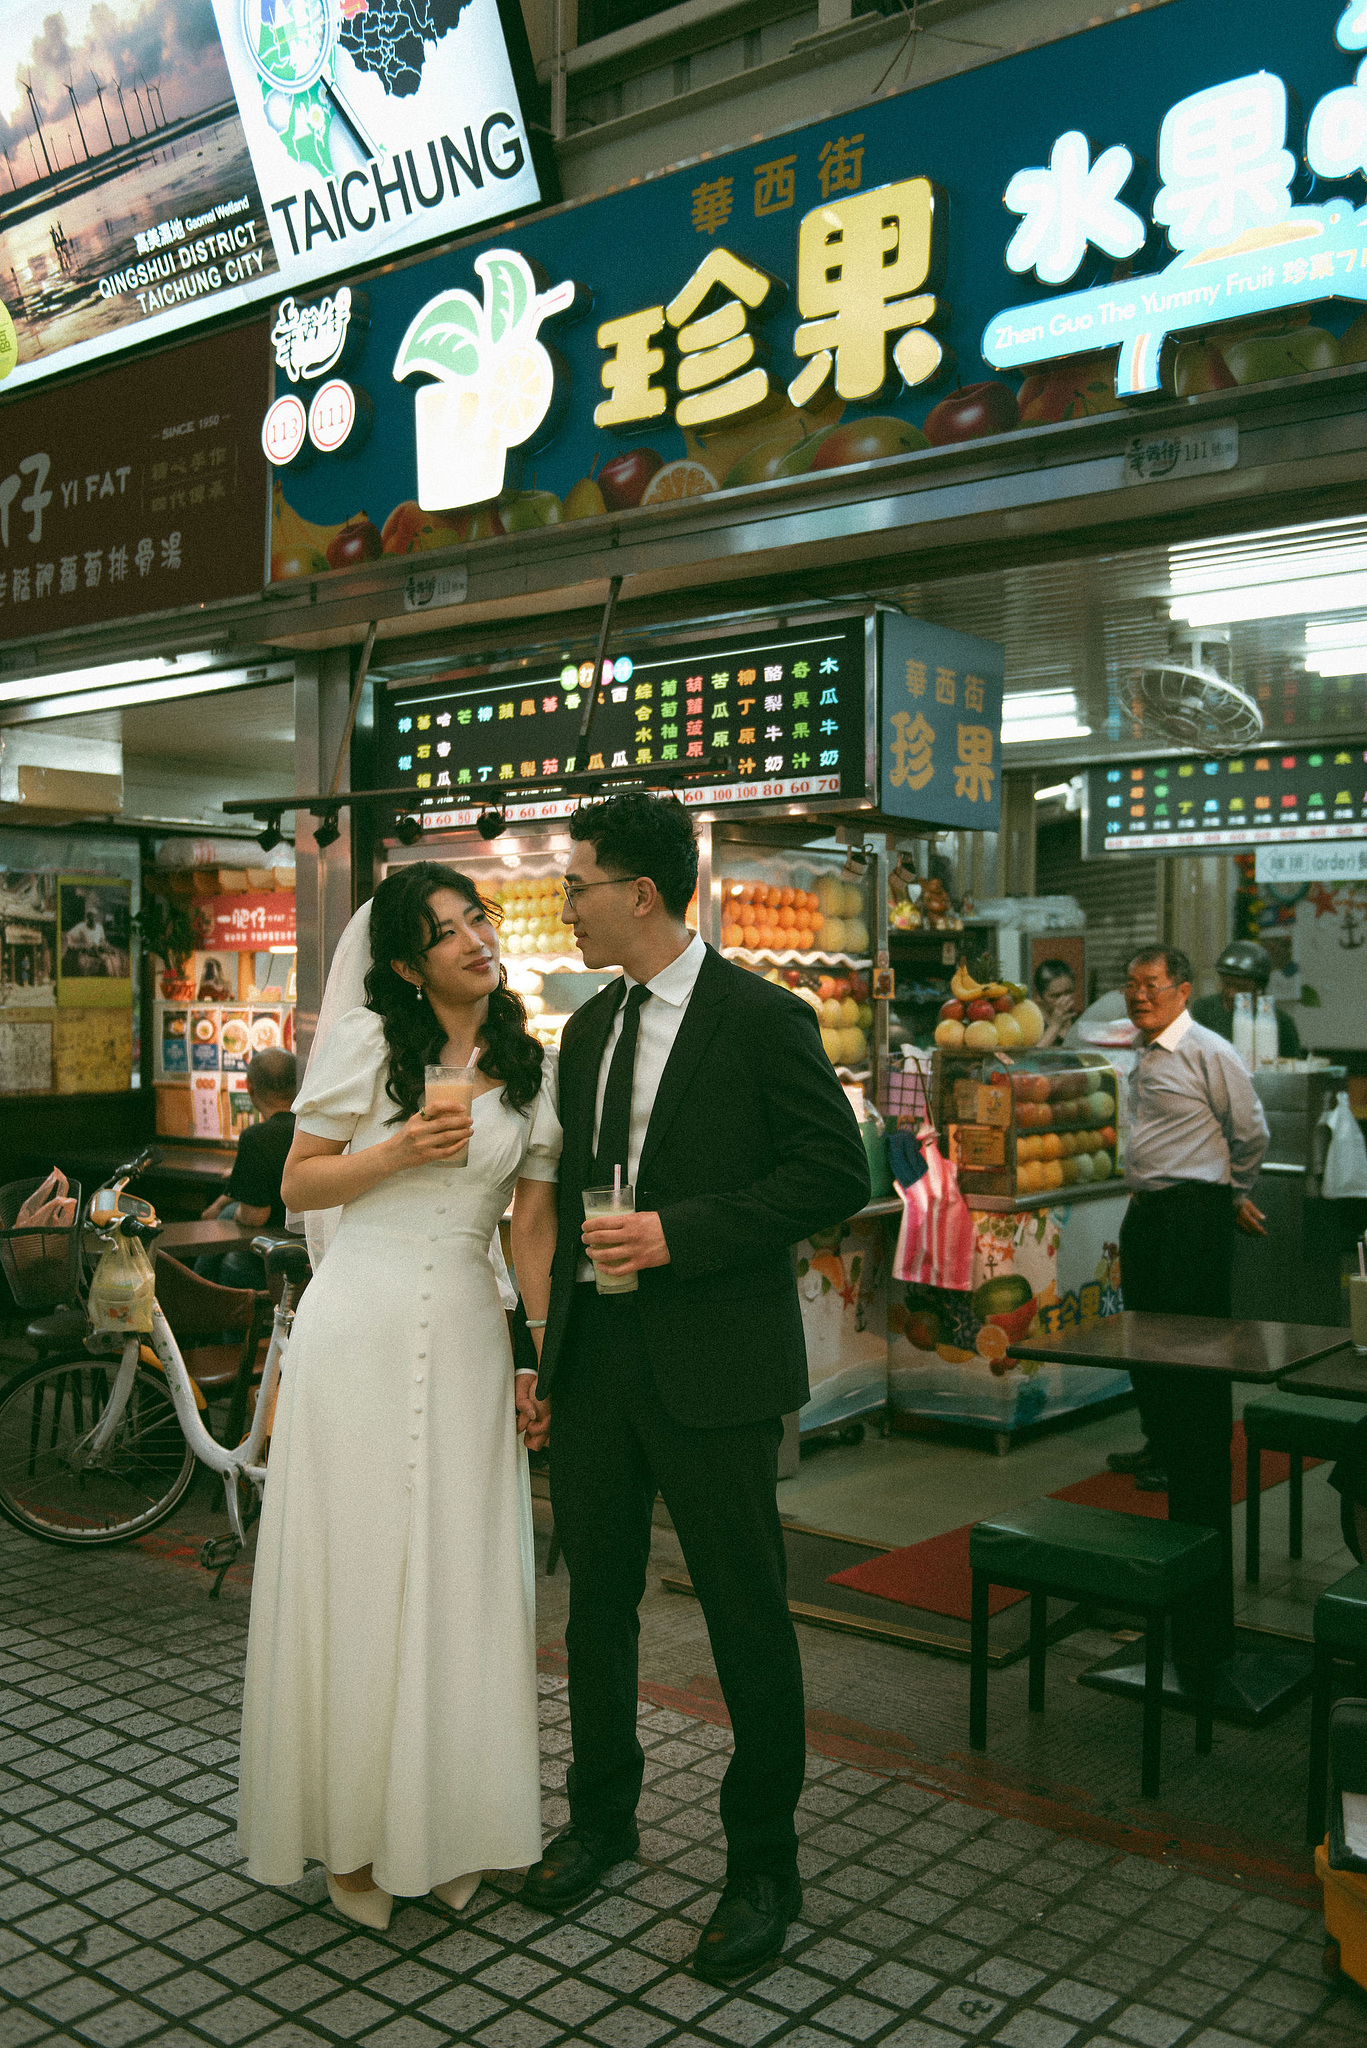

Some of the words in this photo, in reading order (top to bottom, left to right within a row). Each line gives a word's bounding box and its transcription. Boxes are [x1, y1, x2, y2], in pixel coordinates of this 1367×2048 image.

[184, 208, 215, 232] Gaomei
[214, 194, 250, 220] Wetland
[271, 111, 525, 256] TAICHUNG
[691, 133, 865, 235] 華西街
[98, 252, 177, 299] QINGSHUI
[178, 219, 257, 270] DISTRICT
[136, 265, 222, 314] TAICHUNG
[224, 248, 264, 283] CITY
[594, 176, 943, 427] 珍果
[994, 323, 1045, 350] Zhen
[1048, 312, 1094, 337] Guo
[1098, 302, 1137, 325] The
[1140, 282, 1222, 315] Yummy
[1225, 265, 1276, 296] Fruit
[60, 479, 79, 509] YI
[85, 465, 131, 502] FAT
[1185, 440, 1207, 461] 111
[610, 686, 629, 768] 西瓜
[634, 683, 653, 765] 綜合水果
[711, 672, 731, 778] 苦瓜原
[737, 668, 757, 775] 柳丁原汁
[763, 664, 784, 773] 酪梨牛奶
[791, 660, 811, 770] 奇異果汁
[818, 656, 840, 767] 木瓜牛奶
[905, 657, 986, 714] 華西街
[889, 710, 995, 804] 珍果
[435, 814, 452, 826] 60
[457, 811, 471, 824] 80
[519, 806, 536, 818] 60
[541, 803, 558, 816] 60
[684, 789, 704, 803] 60
[712, 788, 733, 801] 100
[736, 784, 758, 799] 100
[762, 782, 784, 797] 80
[790, 780, 810, 794] 60
[818, 778, 840, 792] 70
